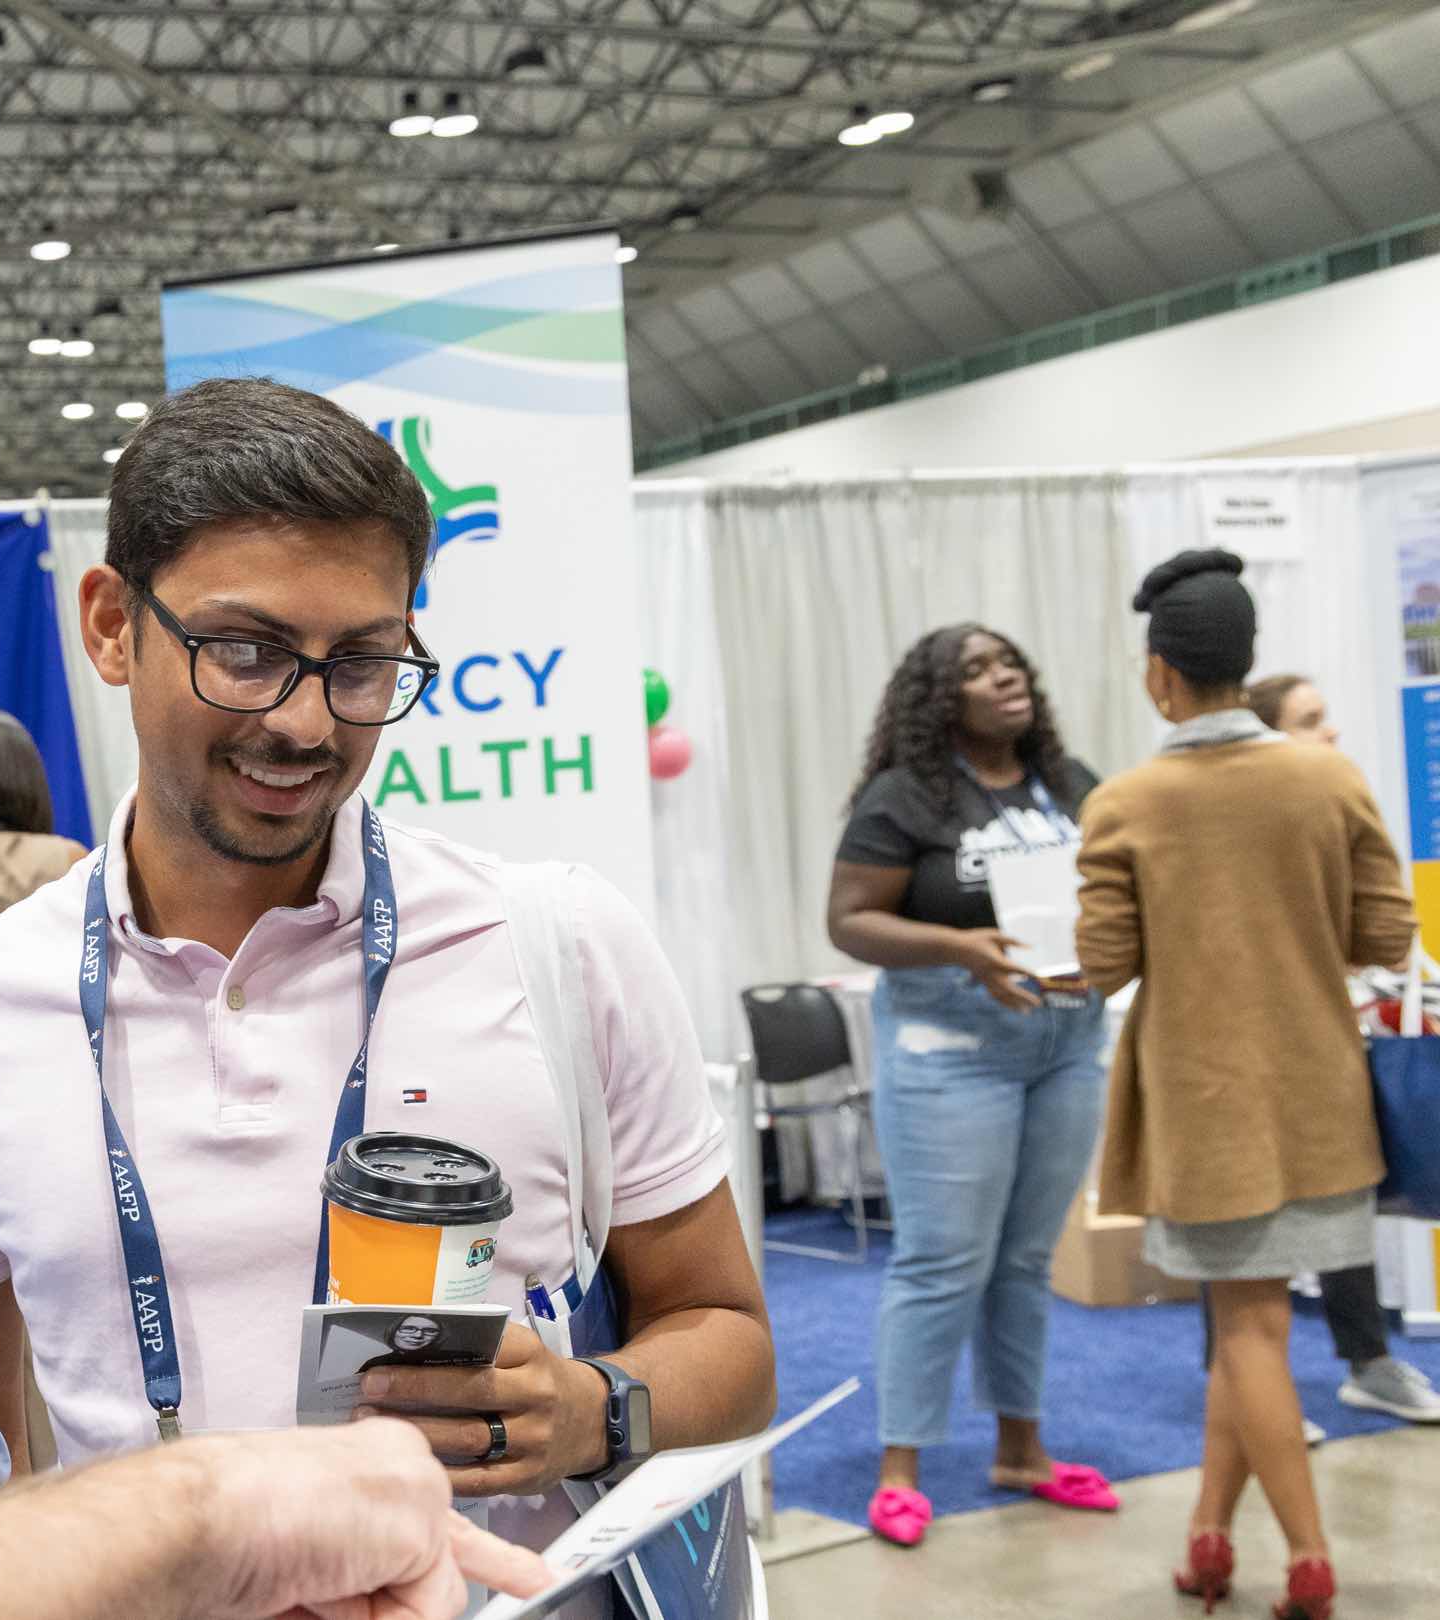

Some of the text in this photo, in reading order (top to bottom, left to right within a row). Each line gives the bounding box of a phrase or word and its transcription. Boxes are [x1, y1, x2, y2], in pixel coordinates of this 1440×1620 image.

[374, 734, 593, 808] ALTH
[374, 898, 393, 955] AAFP
[82, 935, 100, 985] AAFP
[112, 1162, 141, 1222] AAFP
[135, 1289, 164, 1353] AAFP
